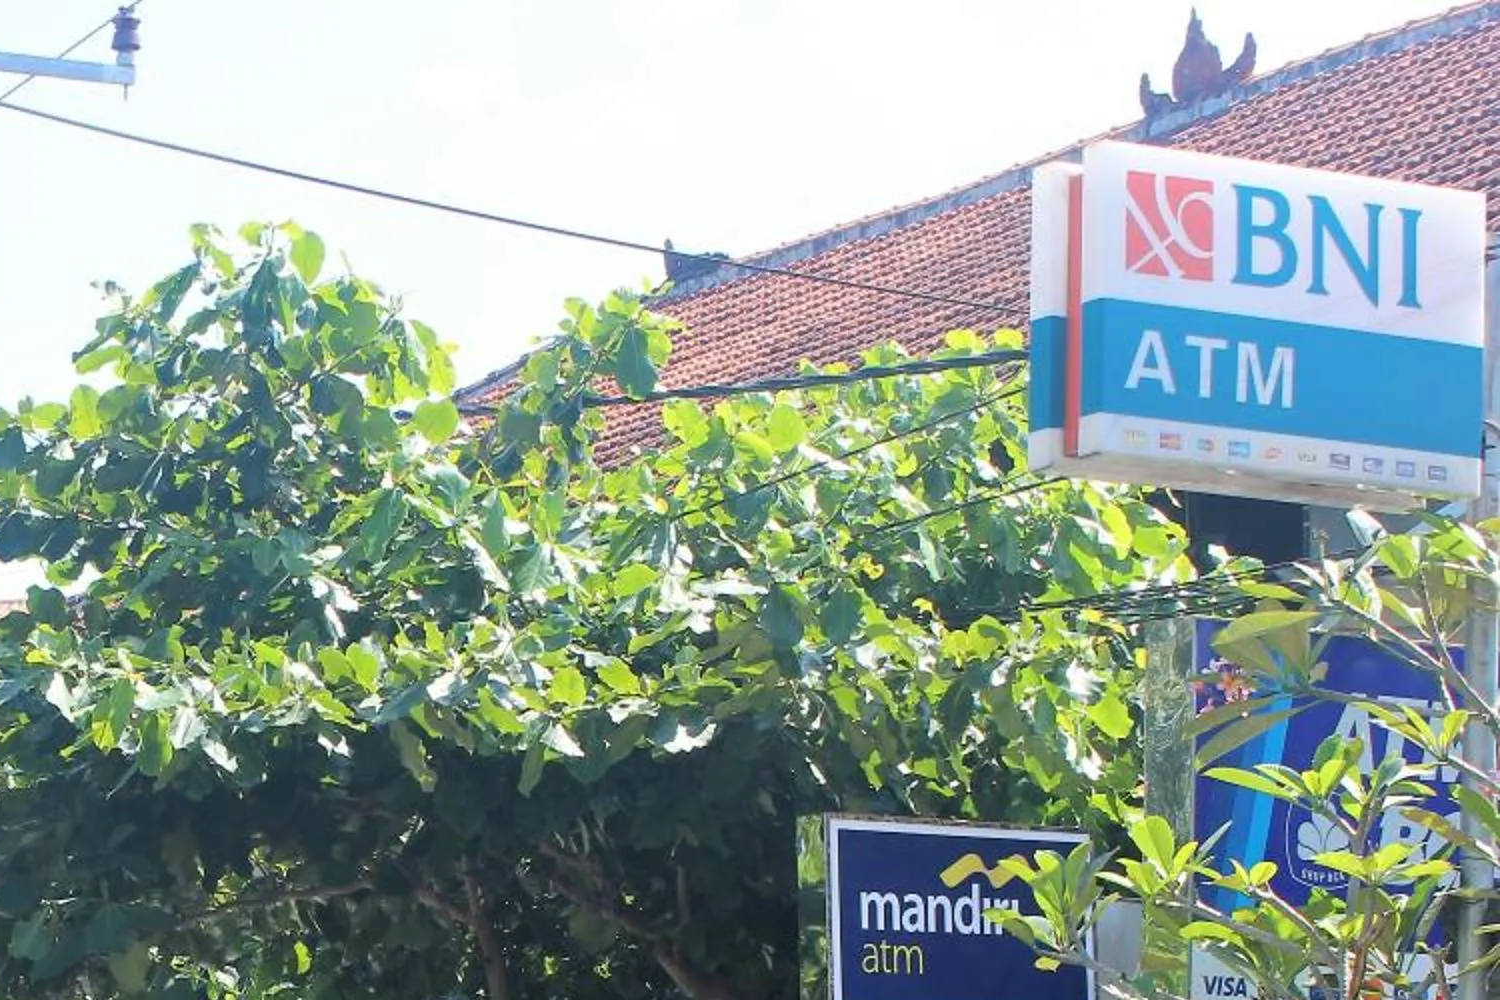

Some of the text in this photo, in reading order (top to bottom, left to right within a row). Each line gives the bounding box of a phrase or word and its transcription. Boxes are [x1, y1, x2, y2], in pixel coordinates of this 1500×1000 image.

[1230, 183, 1424, 309] BNI
[1124, 329, 1294, 409] ATM
[862, 939, 924, 975] atm
[1203, 975, 1247, 997] VISA
